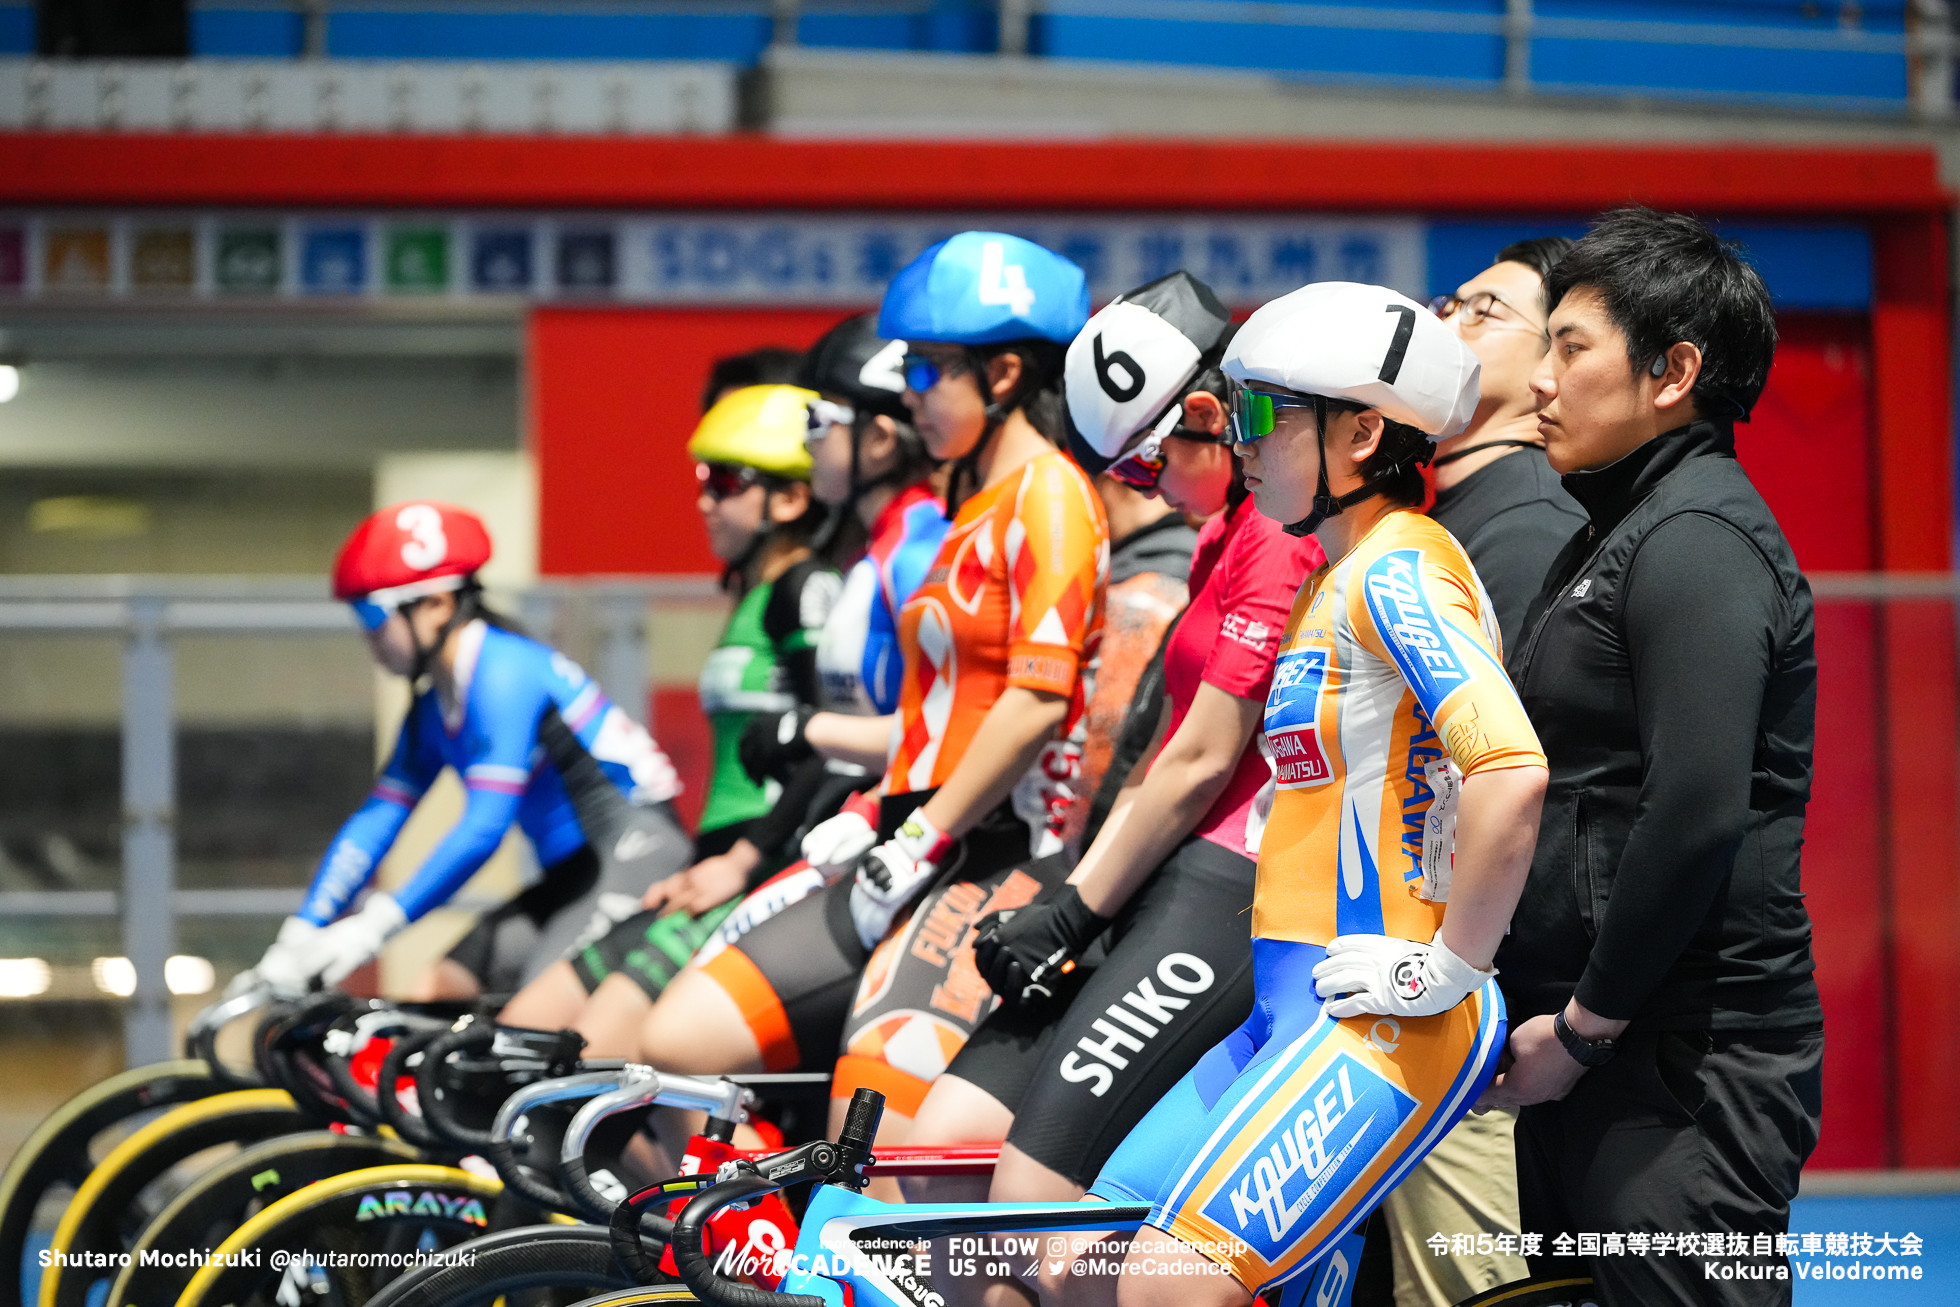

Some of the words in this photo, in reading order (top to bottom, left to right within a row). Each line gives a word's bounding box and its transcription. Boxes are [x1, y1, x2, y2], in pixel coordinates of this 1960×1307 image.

[980, 242, 1035, 315] 4
[1093, 331, 1146, 402] 6
[396, 504, 448, 571] 3
[911, 881, 987, 967] FUKUI
[1059, 952, 1215, 1097] SHIKO
[355, 1191, 488, 1227] ARAYA
[1296, 1191, 1313, 1213] CYCLE
